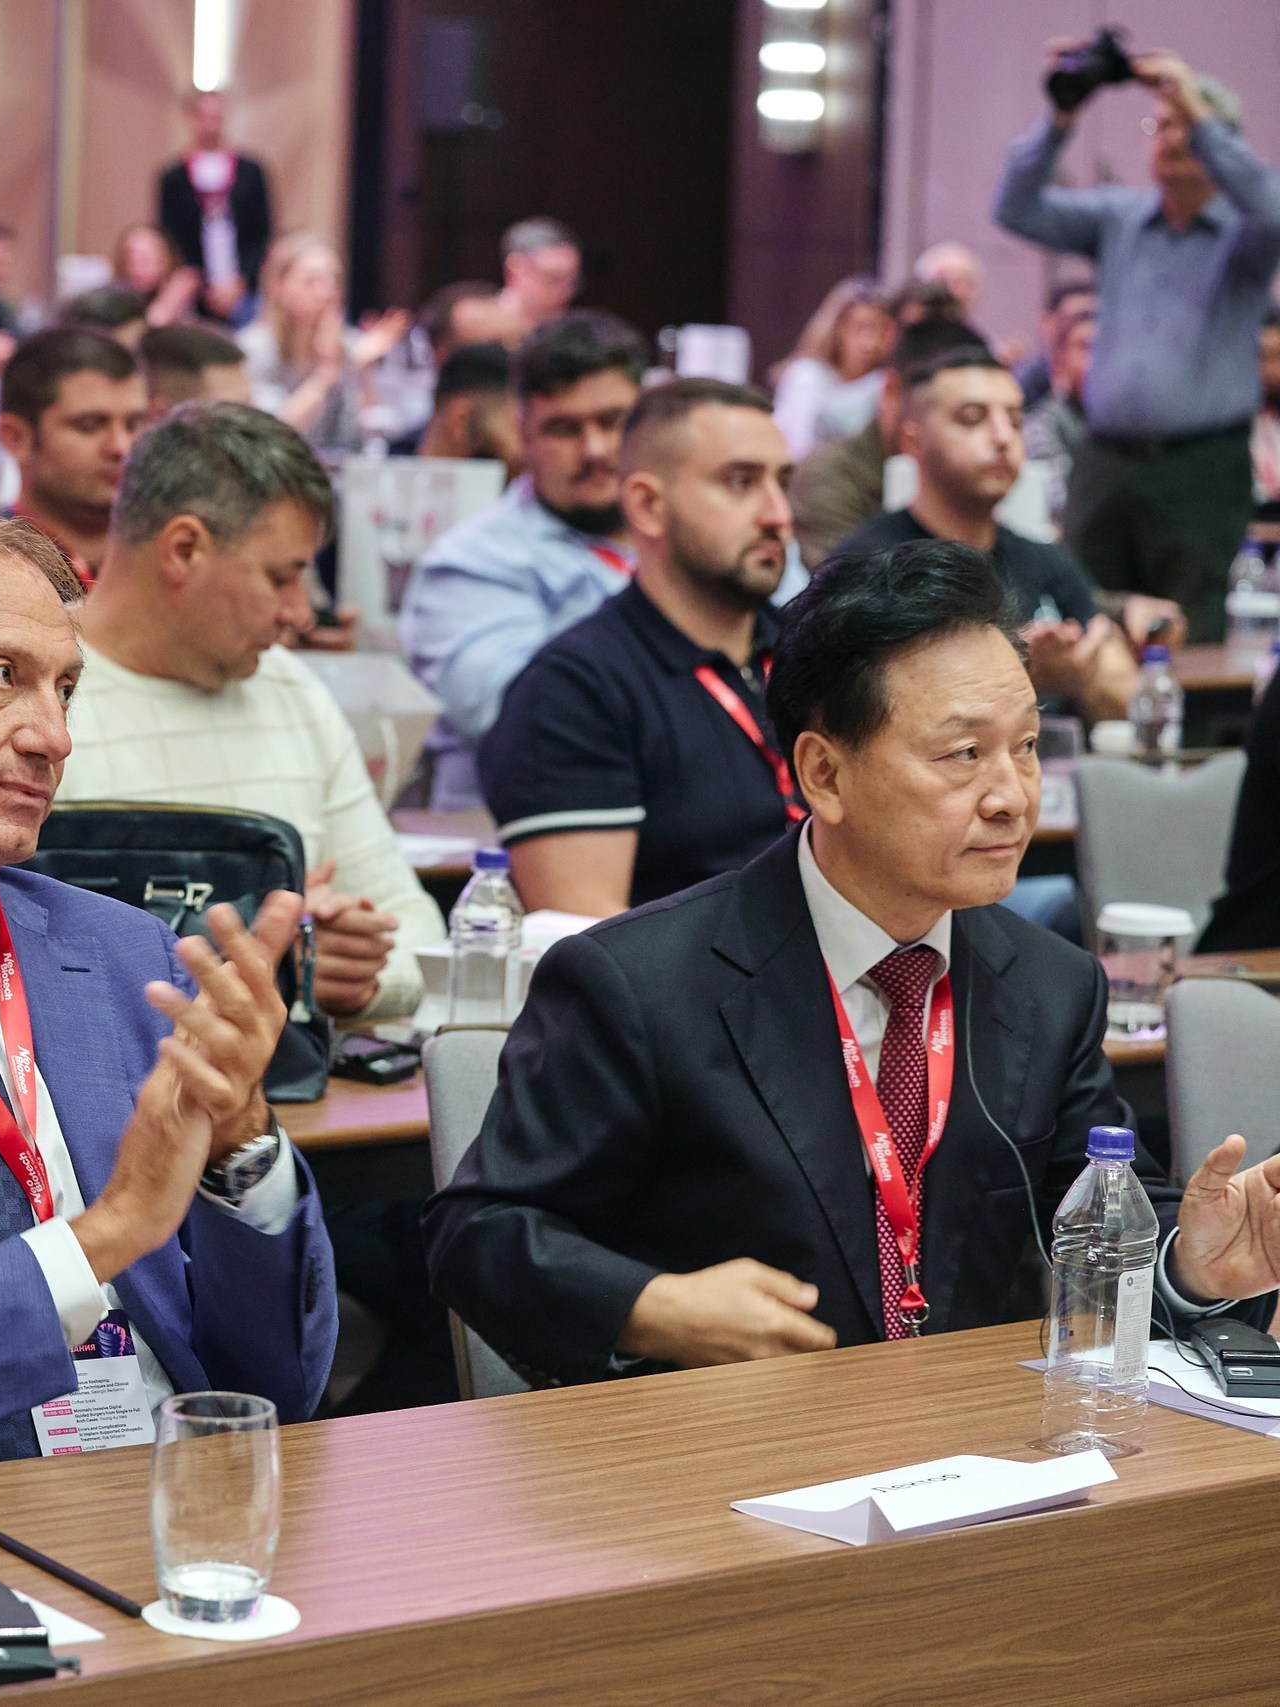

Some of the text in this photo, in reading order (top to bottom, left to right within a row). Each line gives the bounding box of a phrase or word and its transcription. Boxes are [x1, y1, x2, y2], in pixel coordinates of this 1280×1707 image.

[3, 952, 15, 976] Neo
[1, 963, 13, 1000] Biotech
[18, 1045, 31, 1073] Neo
[841, 1038, 859, 1062] Neo
[874, 1132, 892, 1156] Neo
[19, 1152, 43, 1192] Biotech
[873, 1142, 892, 1182] Biotech
[26, 1180, 41, 1204] Neo
